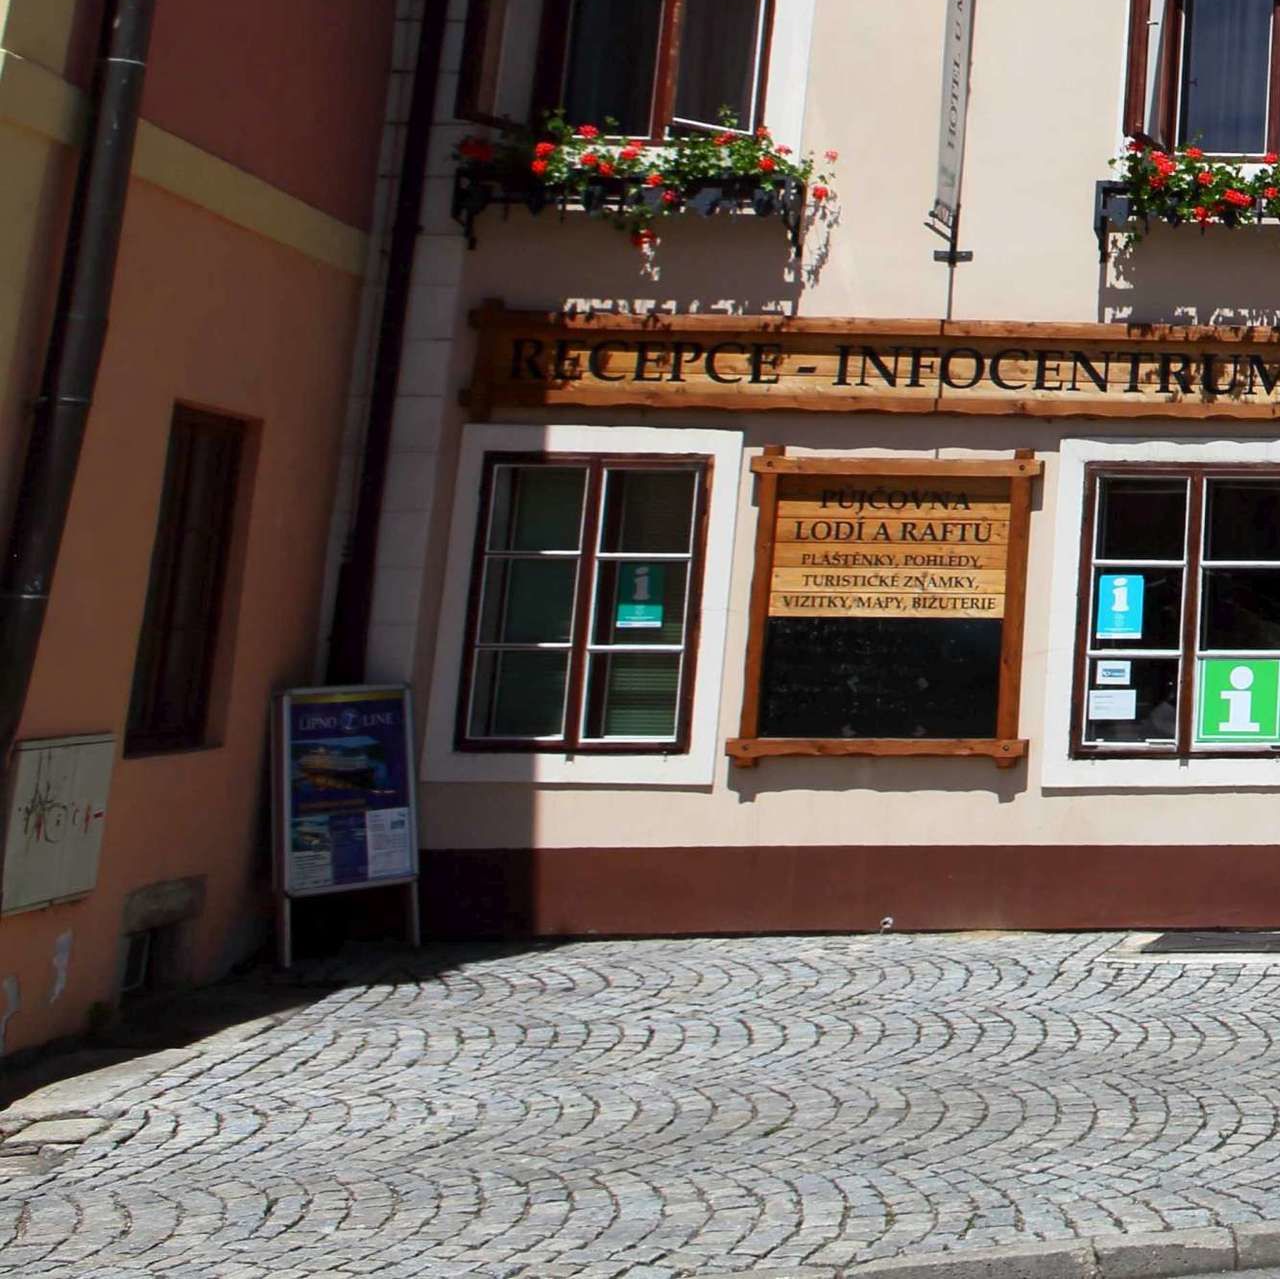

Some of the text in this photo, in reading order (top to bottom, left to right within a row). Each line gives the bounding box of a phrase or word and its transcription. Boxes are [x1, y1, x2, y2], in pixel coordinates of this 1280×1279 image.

[512, 337, 784, 384] RECEPCE
[821, 486, 971, 515] PŮJČOVNA
[794, 516, 993, 543] LODÍ A RAFTŮ
[783, 594, 996, 611] VIZITKY, MAPY, BIŽUTERIE
